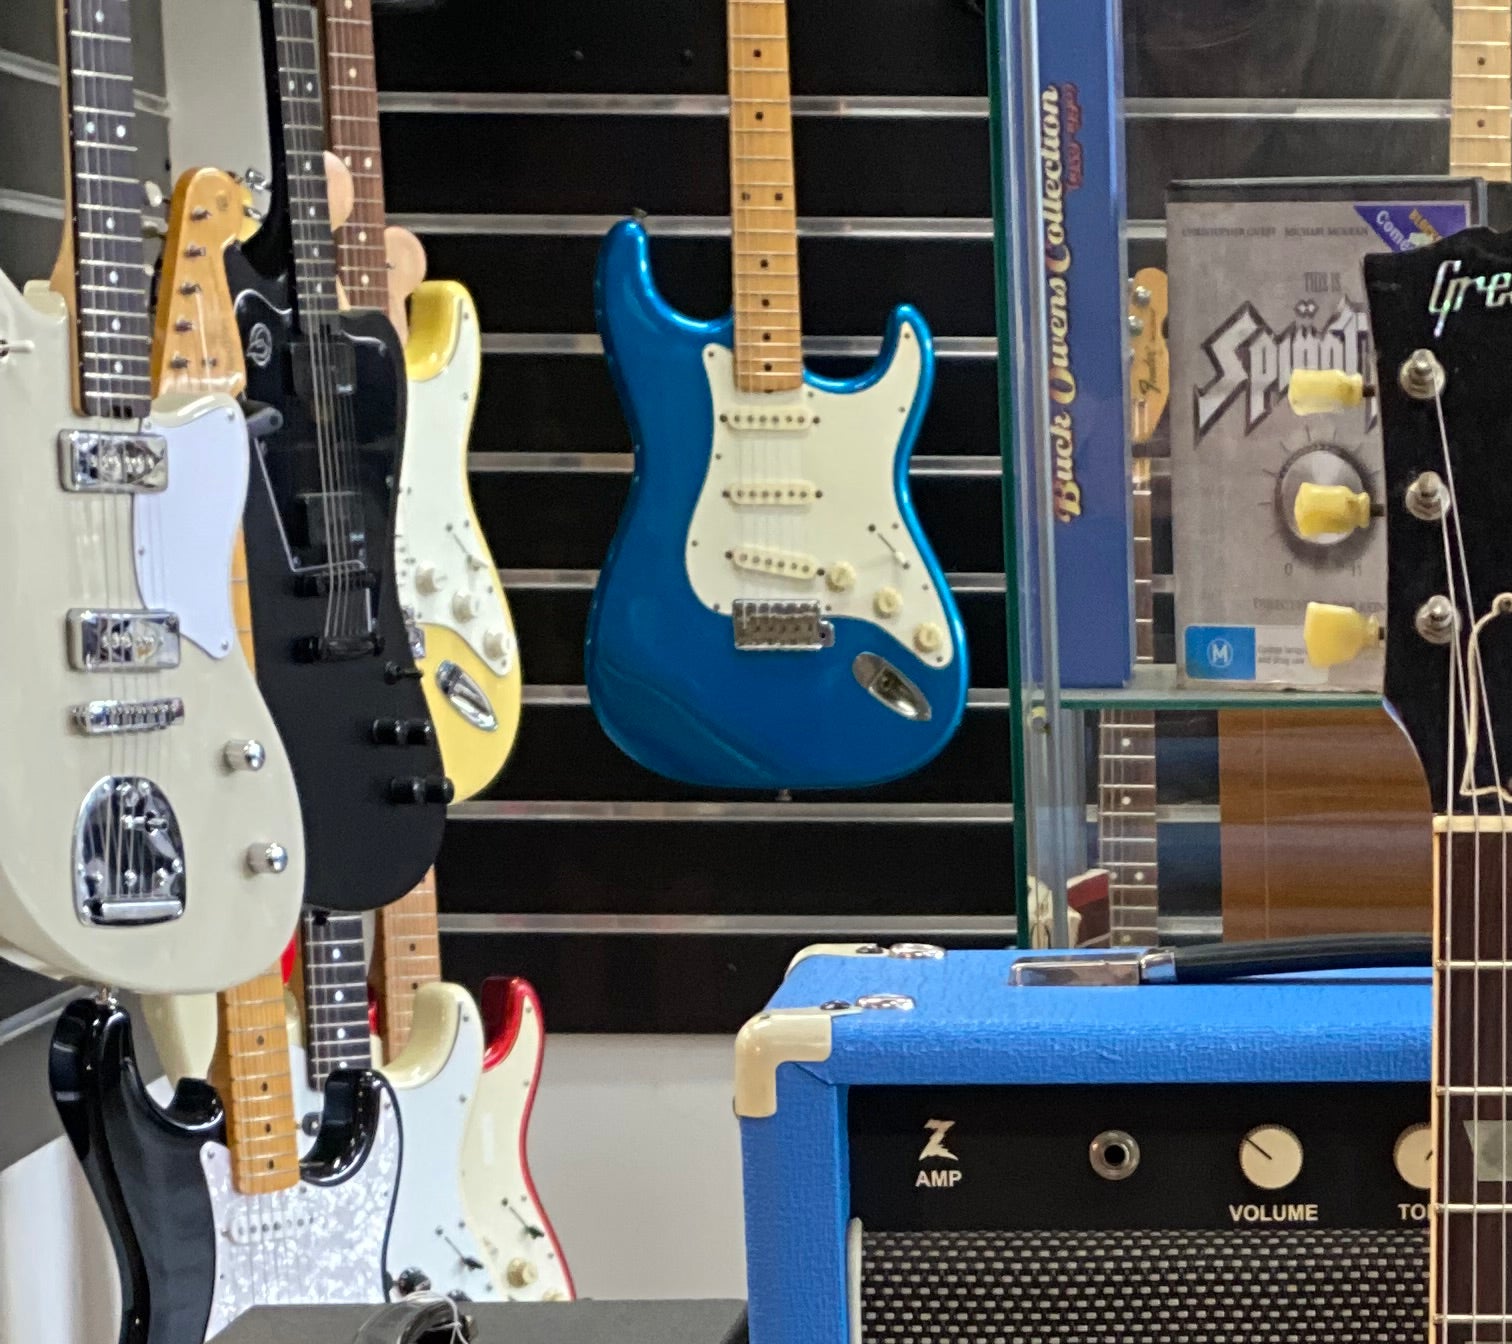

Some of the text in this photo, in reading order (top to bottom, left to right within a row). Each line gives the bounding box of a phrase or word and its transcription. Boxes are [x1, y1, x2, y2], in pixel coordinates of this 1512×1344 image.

[1040, 83, 1072, 274] Collection
[1049, 277, 1077, 405] Owens
[1053, 411, 1083, 523] Buck
[915, 1169, 963, 1188] AMP
[1228, 1204, 1319, 1222] VOLUME
[1397, 1203, 1433, 1221] TO
